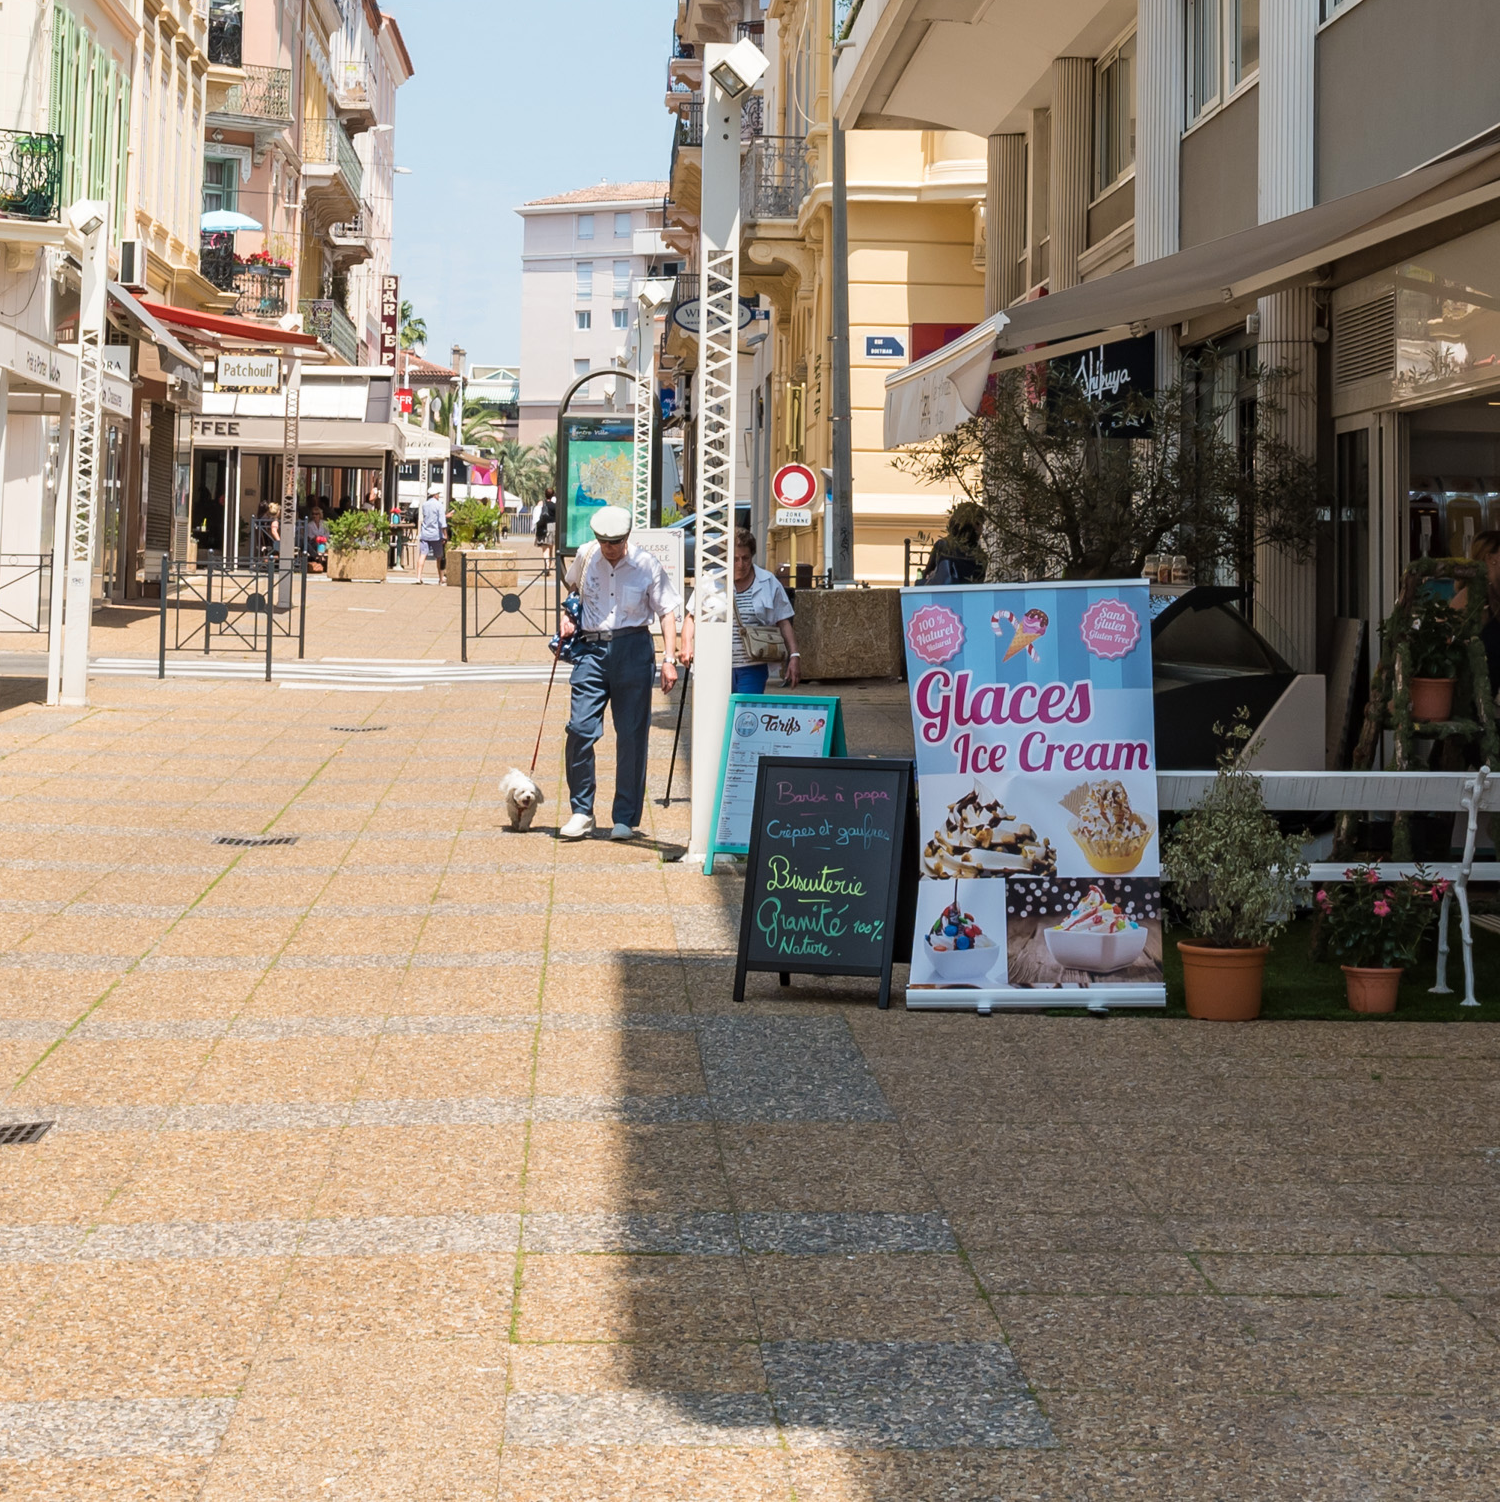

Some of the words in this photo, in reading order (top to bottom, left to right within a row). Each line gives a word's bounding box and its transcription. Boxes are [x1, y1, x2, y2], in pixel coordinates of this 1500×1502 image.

[383, 278, 397, 316] BAR
[1071, 344, 1131, 402] Shibuya
[918, 616, 935, 631] 100
[1094, 616, 1127, 632] Gluten
[1099, 607, 1126, 621] Sans
[916, 623, 955, 646] Naturel
[1088, 630, 1113, 642] Gluten
[1114, 633, 1130, 645] Free
[916, 670, 1091, 743] Glaces
[760, 713, 801, 736] Tarifs
[953, 733, 1007, 774] Ice
[1019, 730, 1150, 773] Cream
[776, 781, 828, 806] Barbe
[835, 786, 844, 803] à
[853, 789, 891, 809] papa
[766, 818, 816, 847] Crêpes
[819, 818, 834, 836] et
[837, 813, 890, 848] gaufres
[766, 855, 868, 897] Biscuiterie
[756, 897, 849, 948] Granité
[853, 919, 884, 942] 100%
